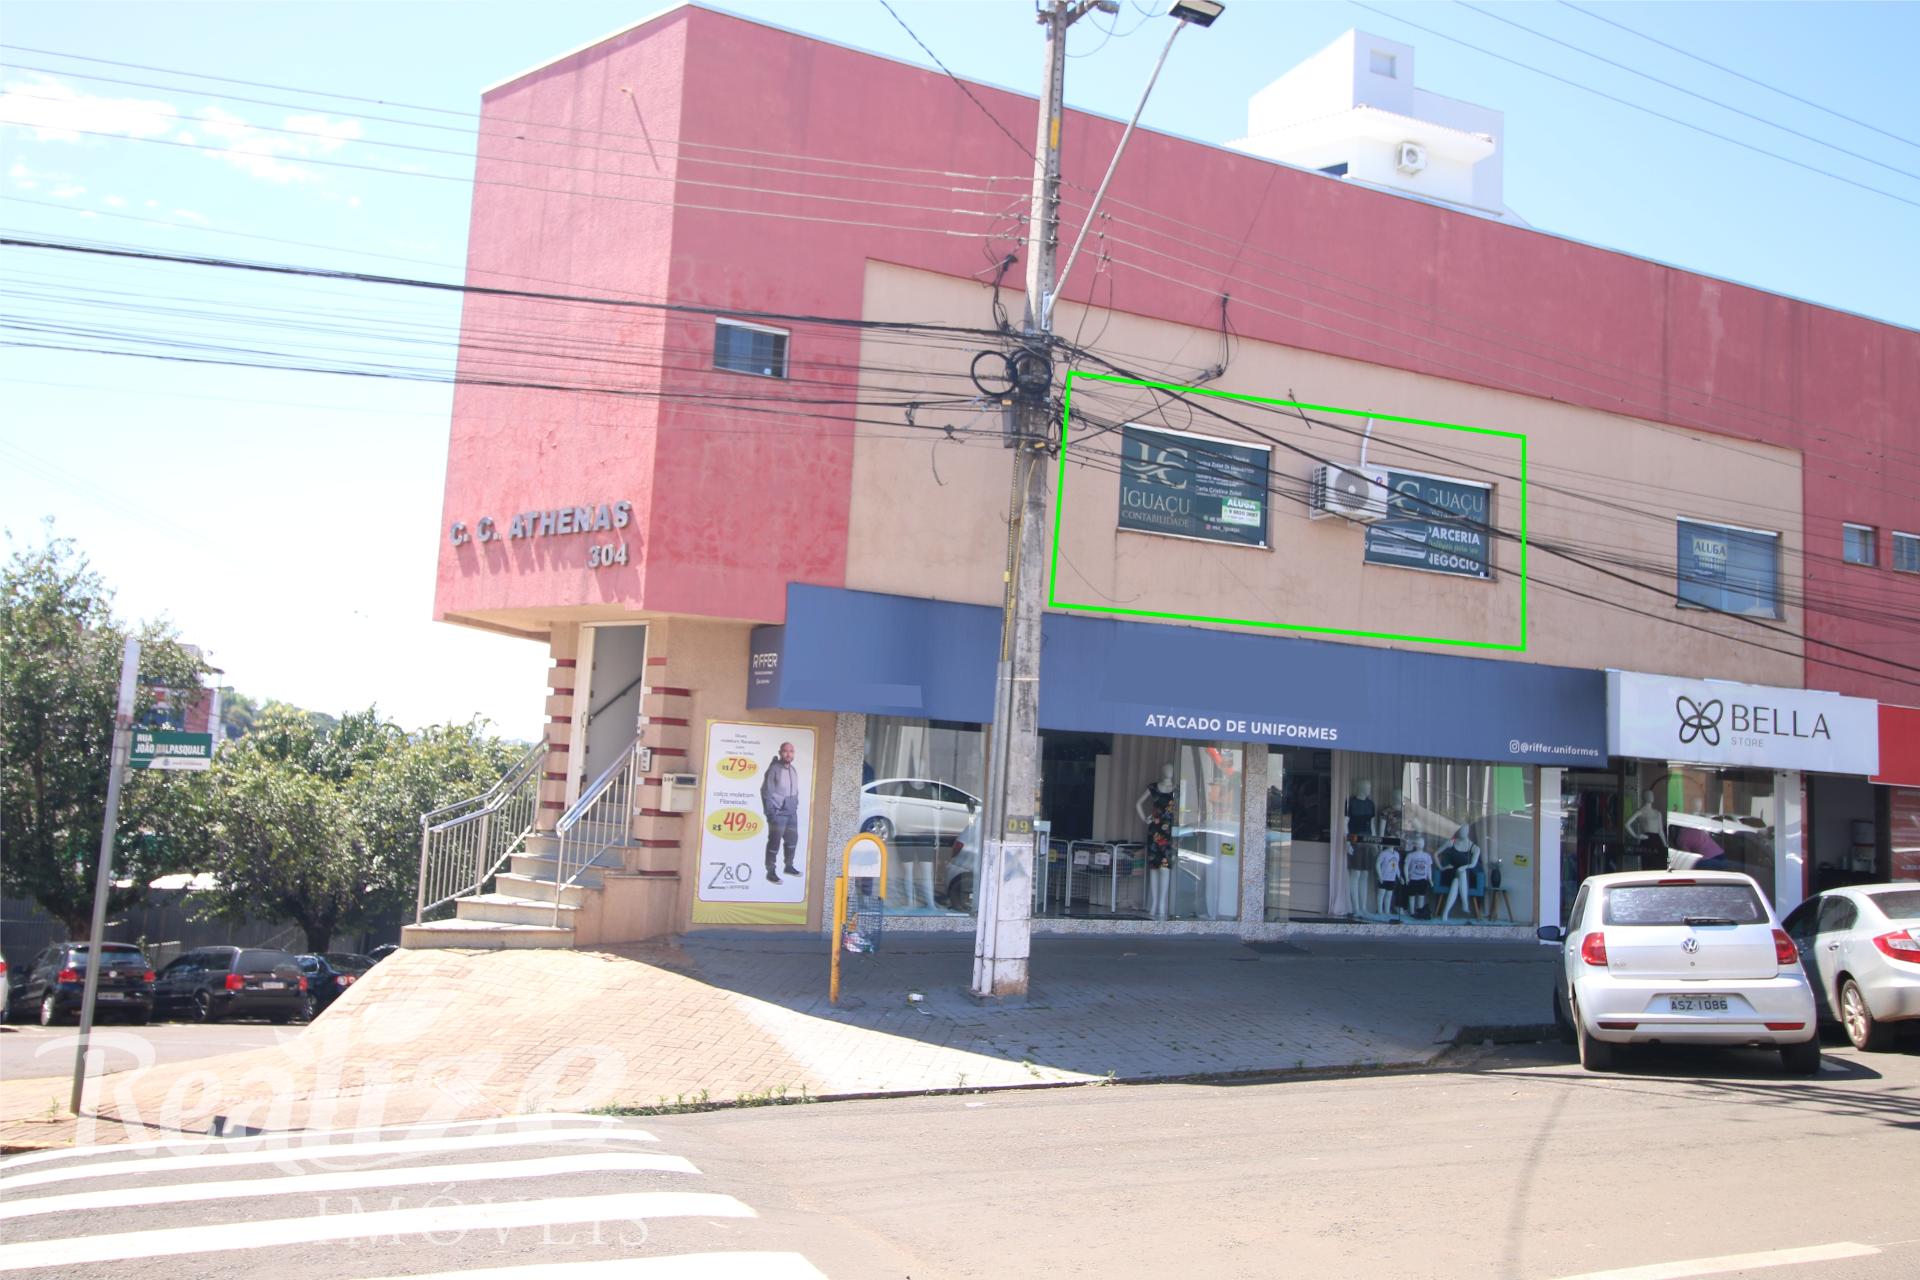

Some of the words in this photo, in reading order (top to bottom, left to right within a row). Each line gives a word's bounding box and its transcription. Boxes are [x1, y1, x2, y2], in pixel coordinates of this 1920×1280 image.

[1123, 486, 1190, 517] IGUAÇU
[1427, 487, 1483, 516] GUAÇU
[508, 500, 632, 541] ATHENAS
[1121, 509, 1189, 528] CONTABILIDADE
[587, 542, 628, 568] 304
[1694, 540, 1727, 557] ALUGA
[1145, 713, 1222, 732] ATACADO
[1225, 719, 1247, 733] DE
[1250, 721, 1338, 741] UNIFORMES
[1731, 703, 1831, 740] BELLA
[136, 733, 153, 742] RUA
[1520, 742, 1599, 756] @riffer.uniformes
[1730, 736, 1765, 748] STORE
